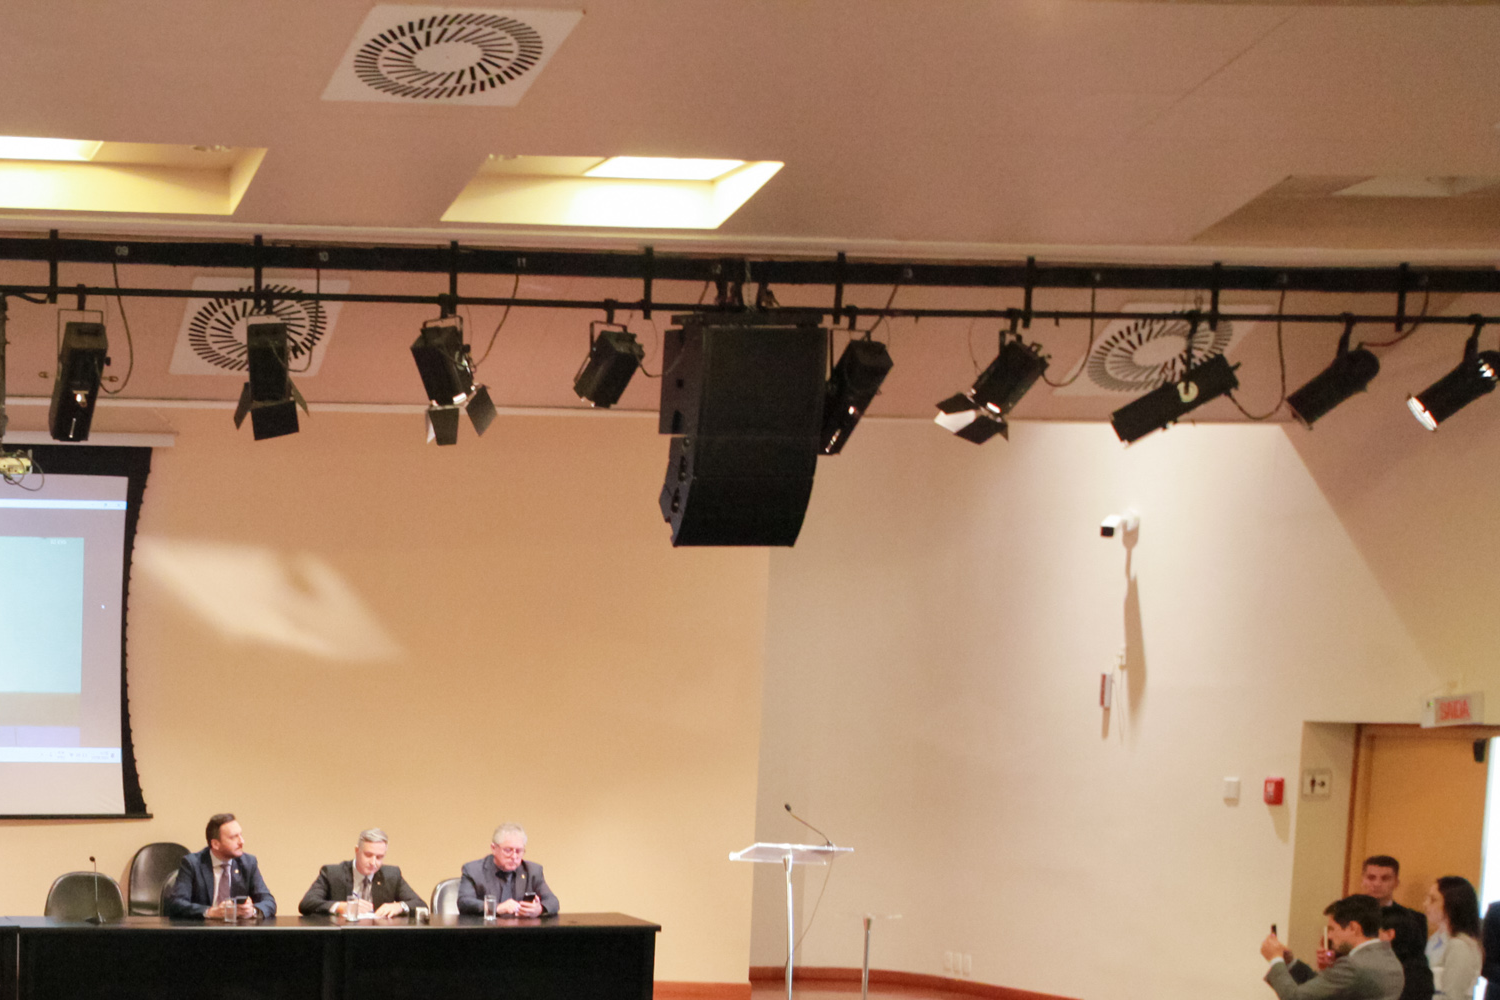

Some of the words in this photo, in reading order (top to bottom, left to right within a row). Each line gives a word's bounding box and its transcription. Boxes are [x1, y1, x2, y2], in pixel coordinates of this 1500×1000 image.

[115, 245, 129, 257] 09
[318, 251, 329, 262] 10
[517, 257, 526, 267] 11
